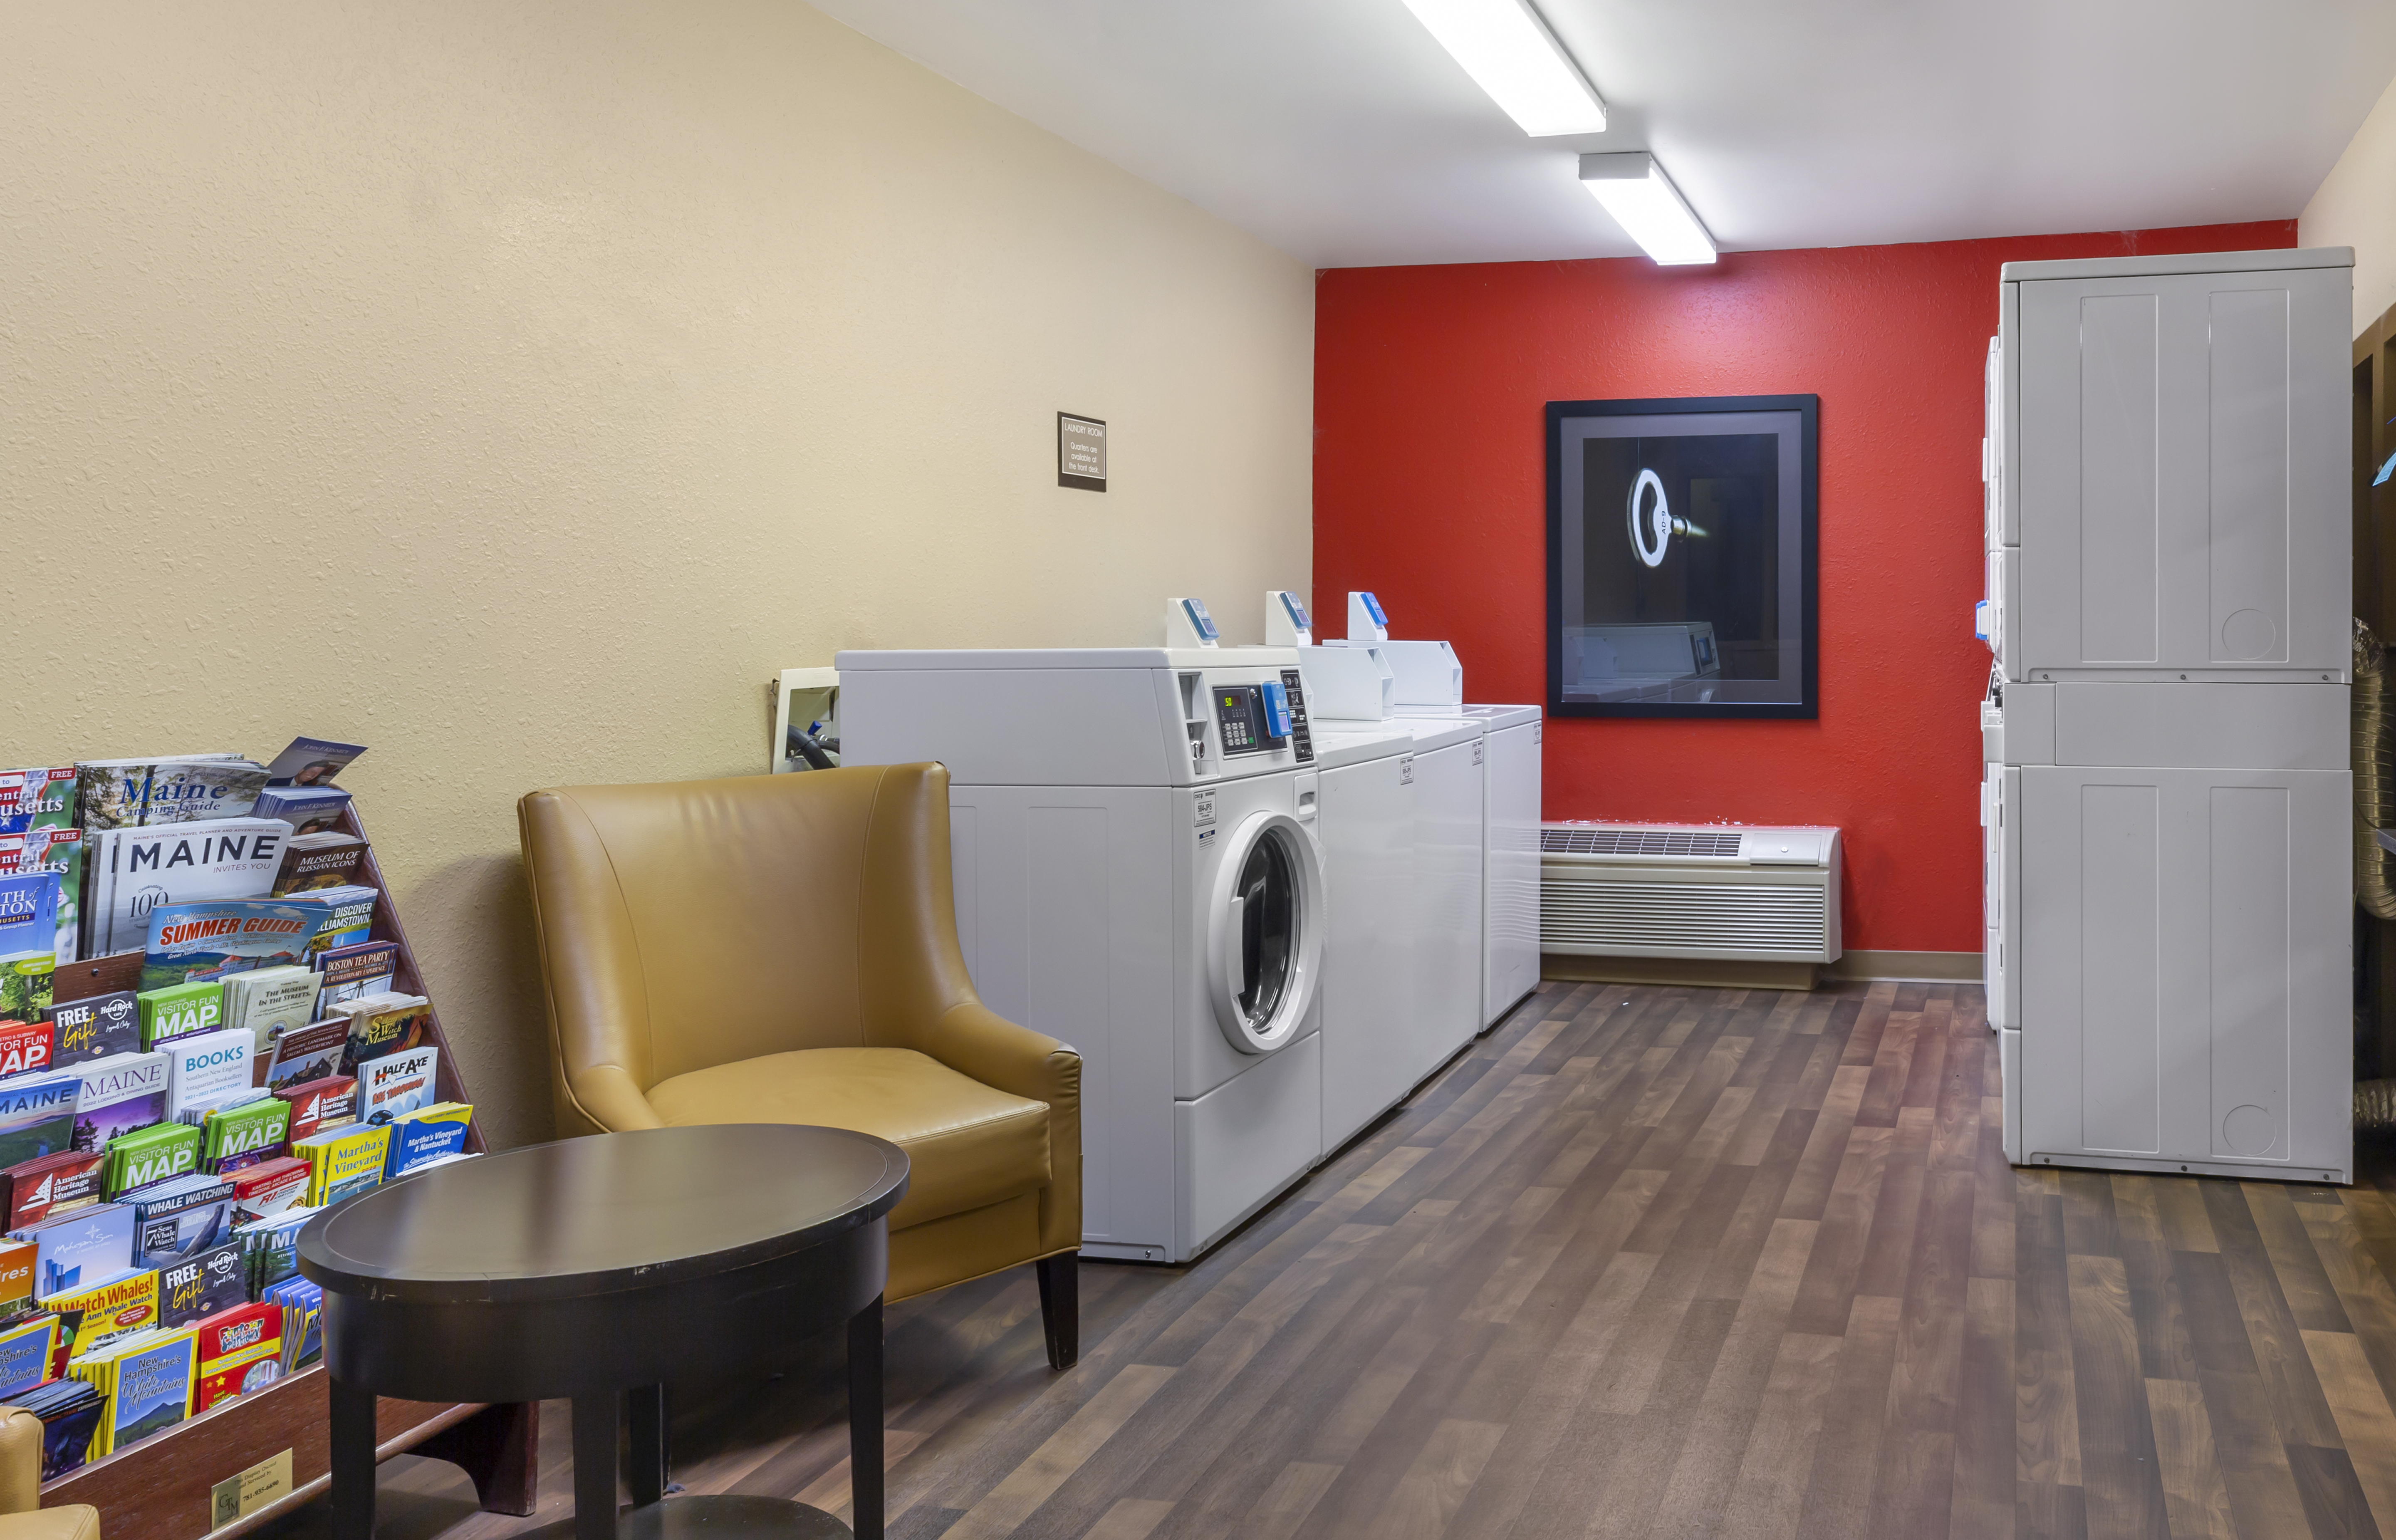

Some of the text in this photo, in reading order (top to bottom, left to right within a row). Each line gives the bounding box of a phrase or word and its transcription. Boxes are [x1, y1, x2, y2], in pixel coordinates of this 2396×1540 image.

[1064, 423, 1102, 437] LAUNDRY ROOM
[1070, 442, 1089, 452] Quarters
[1071, 453, 1091, 462] available
[1077, 463, 1087, 472] front
[119, 777, 228, 805] Maine
[116, 800, 220, 818] Camping Guide
[54, 832, 77, 840] FREE
[130, 835, 280, 872] MAINE
[300, 851, 361, 865] MUSEUM OF
[213, 864, 247, 873] INVITES
[297, 859, 356, 872] RUSSIAN ICONS
[29, 886, 40, 901] of
[130, 891, 168, 918] 100
[334, 902, 372, 918] DISCOVER
[163, 909, 238, 924] New Hampshire
[160, 918, 307, 946] SUMMER GUIDE
[327, 958, 354, 971] BOSTON
[355, 956, 367, 966] TEA
[368, 951, 389, 963] PARTY
[330, 971, 363, 981] REVOLUTIONARY
[363, 965, 386, 975] EXPERIENCE
[280, 985, 309, 994] MUSEUM
[100, 1001, 133, 1015] Hard Rock
[158, 995, 219, 1016] VISITOR FUN
[57, 1006, 89, 1028] FREE
[155, 1004, 218, 1040] MAP
[63, 1012, 98, 1051] Gift
[24, 1034, 47, 1047] FUN
[286, 1040, 334, 1058] SALEM'S WATERFRONT
[287, 1042, 307, 1052] HISTORIC
[307, 1035, 333, 1045] LANDMARK
[186, 1046, 243, 1072] BOOKS
[186, 1072, 208, 1082] Southern
[222, 1062, 243, 1074] England
[375, 1056, 428, 1086] HALF AXE
[83, 1063, 162, 1099] MAINE
[185, 1073, 243, 1092] Antiquarian Booksellers
[210, 1082, 242, 1094] DIRECTORY
[98, 1094, 120, 1103] LODGING
[321, 1092, 353, 1105] American
[372, 1077, 426, 1106] AXE THROWING!
[0, 1089, 73, 1114] MAINE
[321, 1100, 348, 1111] Heritage
[321, 1106, 348, 1118] Museum
[226, 1113, 286, 1134] VISITOR FUN
[221, 1123, 283, 1159] MAP
[408, 1127, 463, 1147] Martha's Vineyard
[420, 1138, 451, 1151] Nantucket
[129, 1139, 194, 1165] VISITOR FUN
[337, 1137, 384, 1161] Martha's
[126, 1149, 193, 1189] MAP
[335, 1150, 382, 1174] Vineyard
[54, 1170, 97, 1186] American
[282, 1168, 304, 1179] THROWING
[53, 1179, 89, 1193] Heritage
[272, 1179, 288, 1188] ARCADE
[52, 1186, 89, 1201] Museum
[148, 1196, 183, 1215] WHALE
[186, 1184, 233, 1205] WATCHING
[95, 1233, 114, 1243] Sun
[147, 1229, 158, 1246] 7
[154, 1230, 175, 1240] Whale
[155, 1237, 175, 1246] Watch
[208, 1252, 238, 1269] Hard Rock
[166, 1263, 197, 1289] FREE
[107, 1275, 153, 1305] Whales!
[173, 1269, 205, 1310] Gift
[87, 1312, 102, 1322] Ann
[104, 1302, 127, 1315] Whale
[130, 1293, 152, 1306] Watch
[87, 1319, 106, 1329] Season!
[219, 1318, 264, 1340] Funtown
[124, 1355, 181, 1382] Hampshire's
[138, 1356, 159, 1369] New
[122, 1374, 159, 1398] White
[213, 1390, 225, 1399] Have
[125, 1377, 186, 1414] Mountains
[208, 1399, 221, 1409] Some
